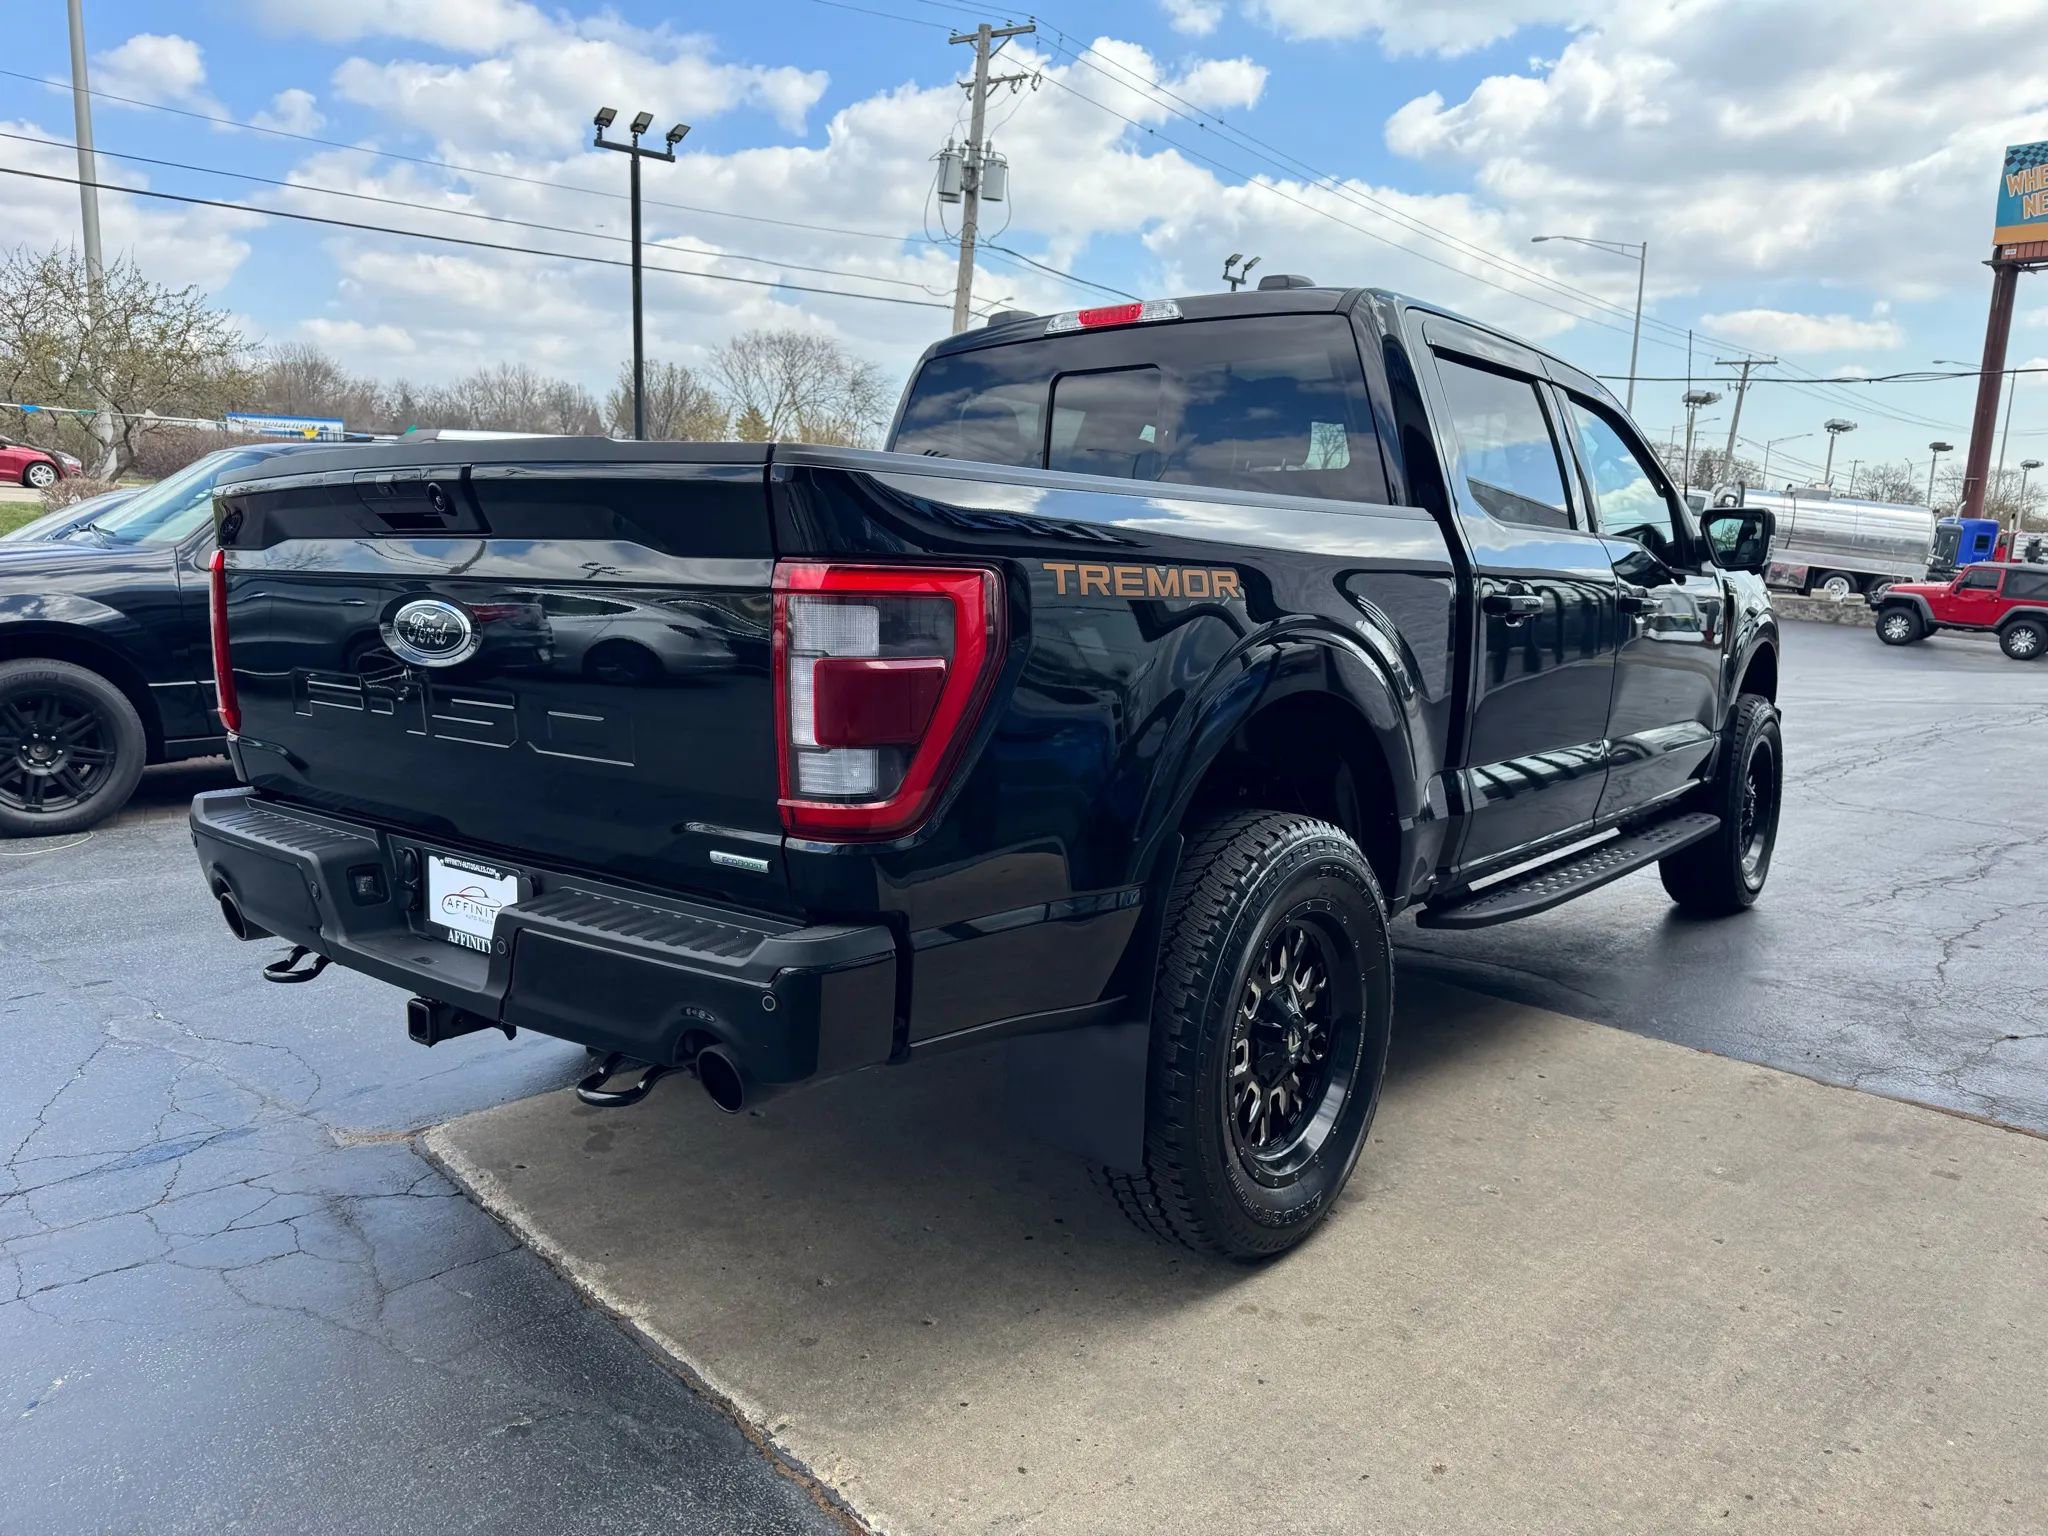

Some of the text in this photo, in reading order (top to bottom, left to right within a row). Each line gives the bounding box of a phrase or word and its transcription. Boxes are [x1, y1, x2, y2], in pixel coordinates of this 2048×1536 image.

[1042, 562, 1240, 598] TREMOR
[407, 612, 447, 645] Ford
[447, 898, 498, 920] AFFINIT
